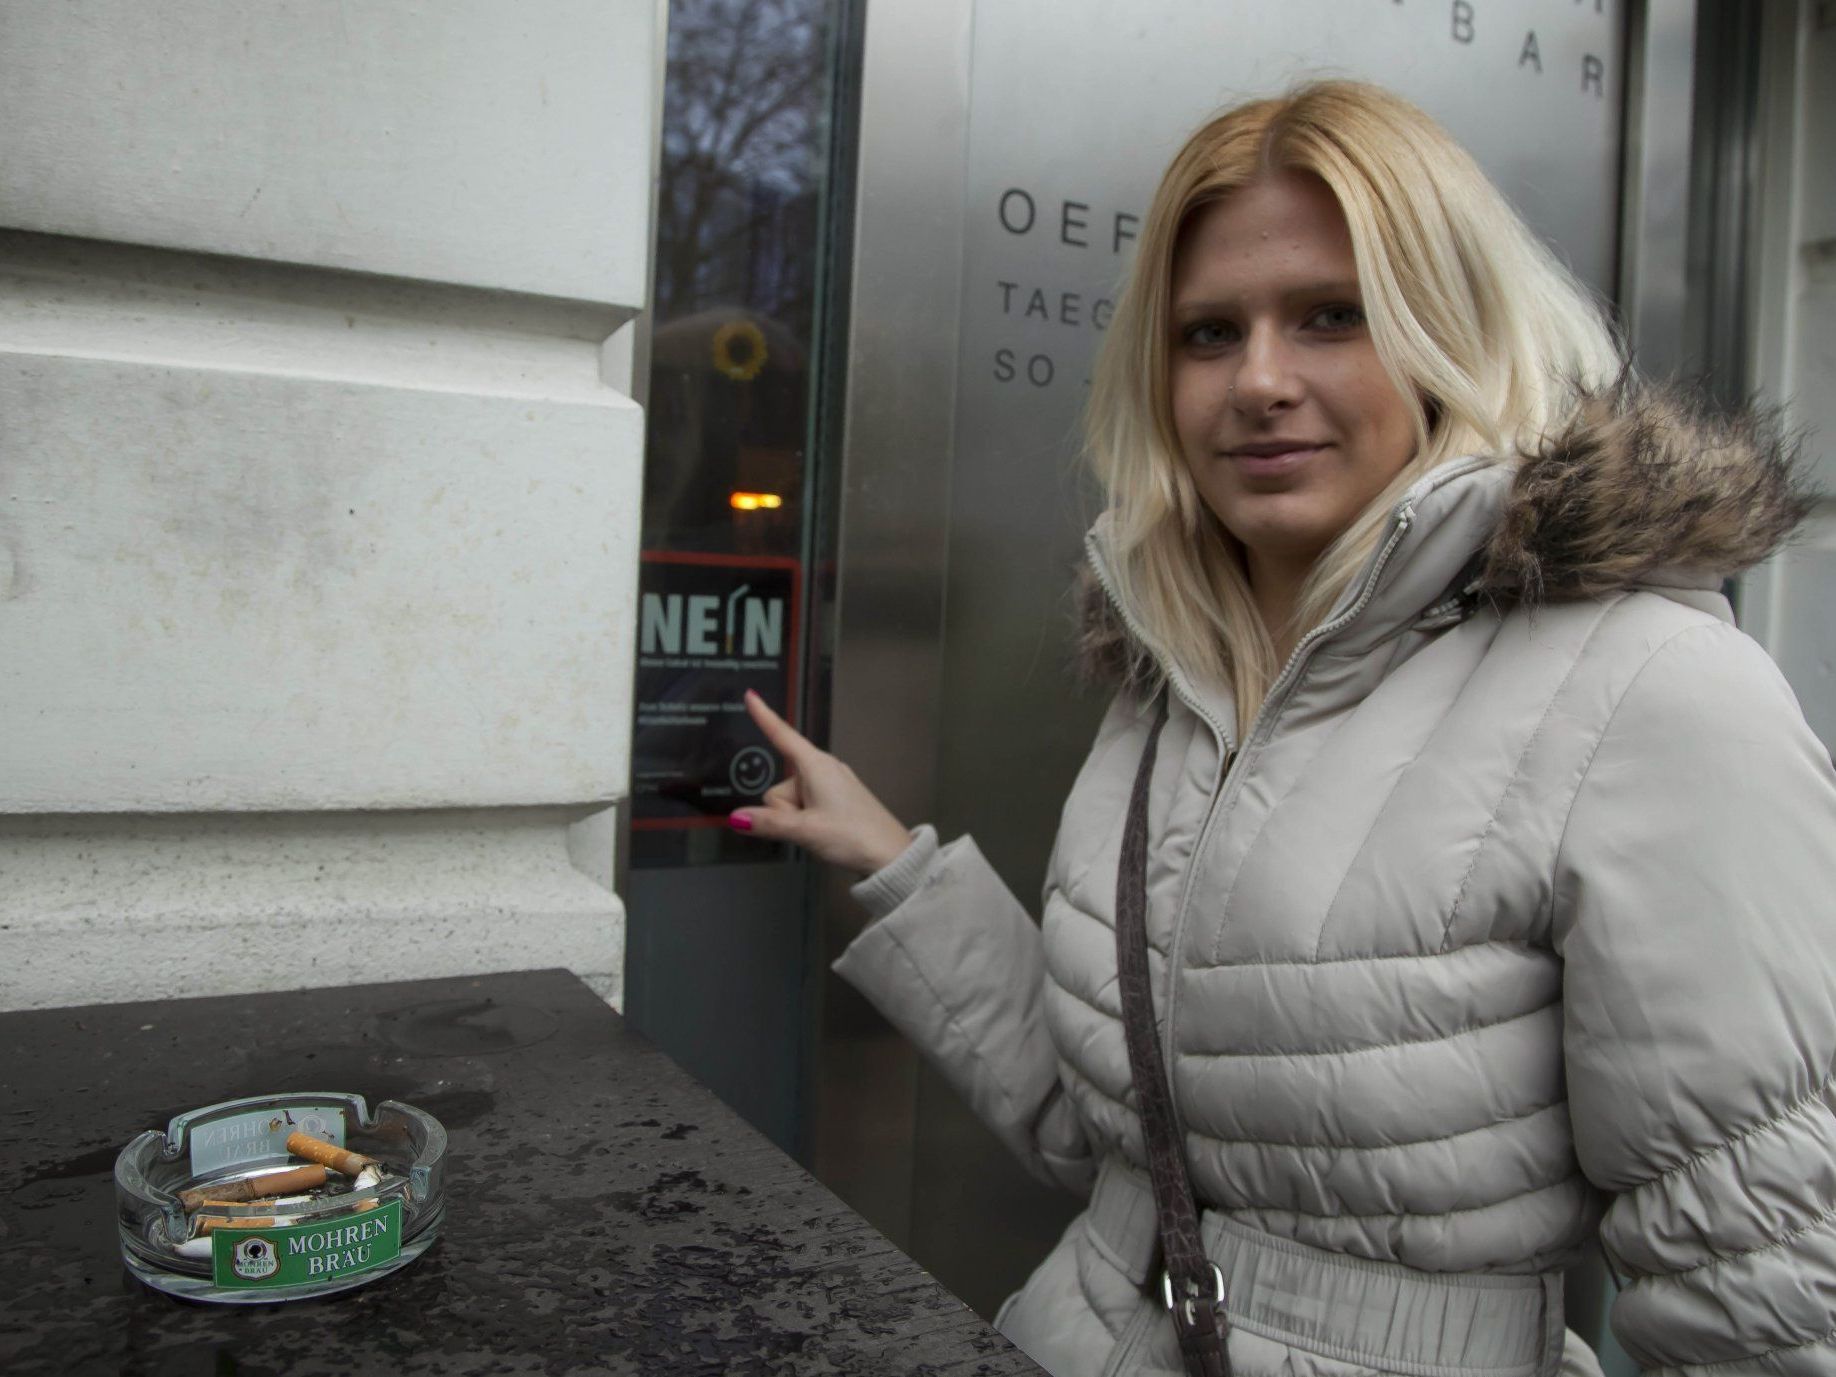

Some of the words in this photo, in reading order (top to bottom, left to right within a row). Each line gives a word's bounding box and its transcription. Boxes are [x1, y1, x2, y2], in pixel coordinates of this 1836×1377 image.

[993, 348, 1055, 388] SO
[640, 584, 784, 657] NEIN
[288, 1214, 389, 1256] MOHREN
[308, 1243, 372, 1276] BRÄU
